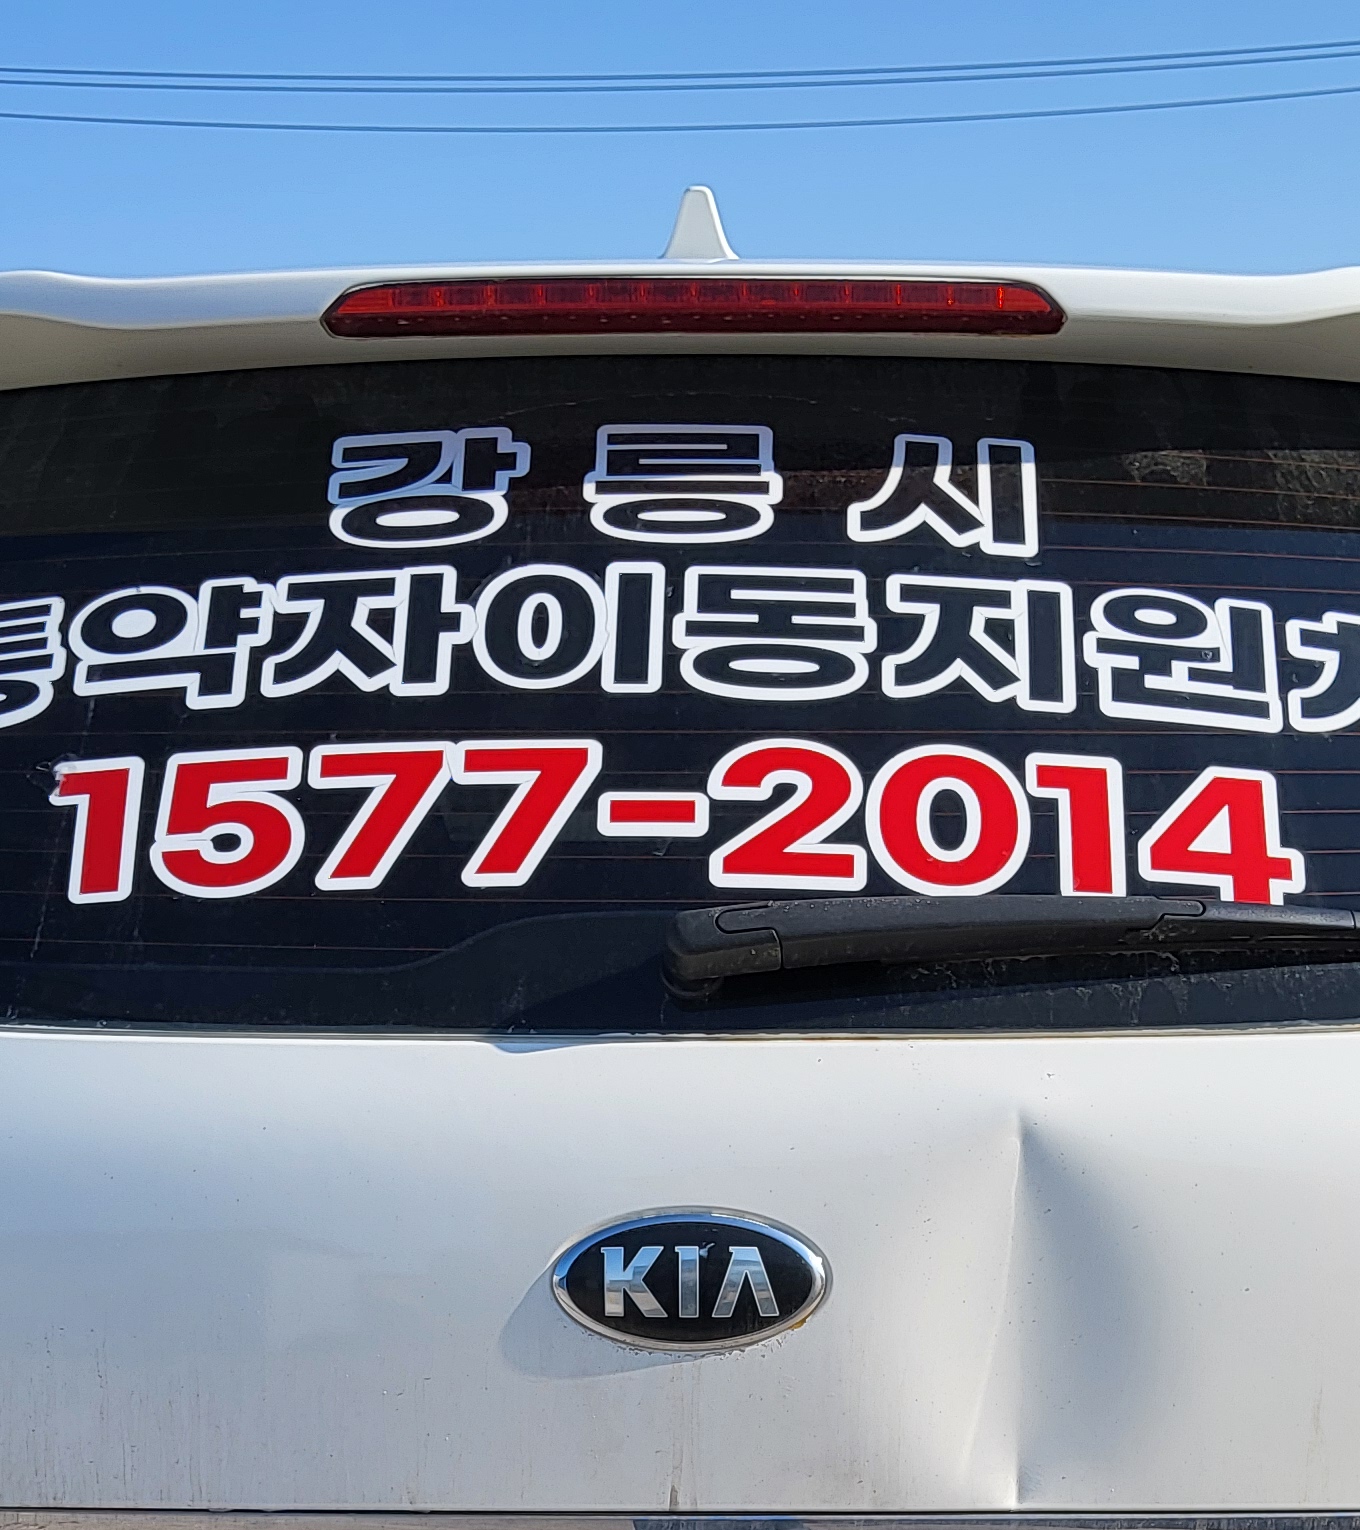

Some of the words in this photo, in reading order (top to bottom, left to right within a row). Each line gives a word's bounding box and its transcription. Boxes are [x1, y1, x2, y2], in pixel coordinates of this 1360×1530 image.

[327, 425, 530, 548] 강
[582, 424, 783, 544] 릉
[847, 433, 1040, 559] 시
[48, 737, 1306, 907] 1577-2014
[600, 1245, 781, 1319] KIA
